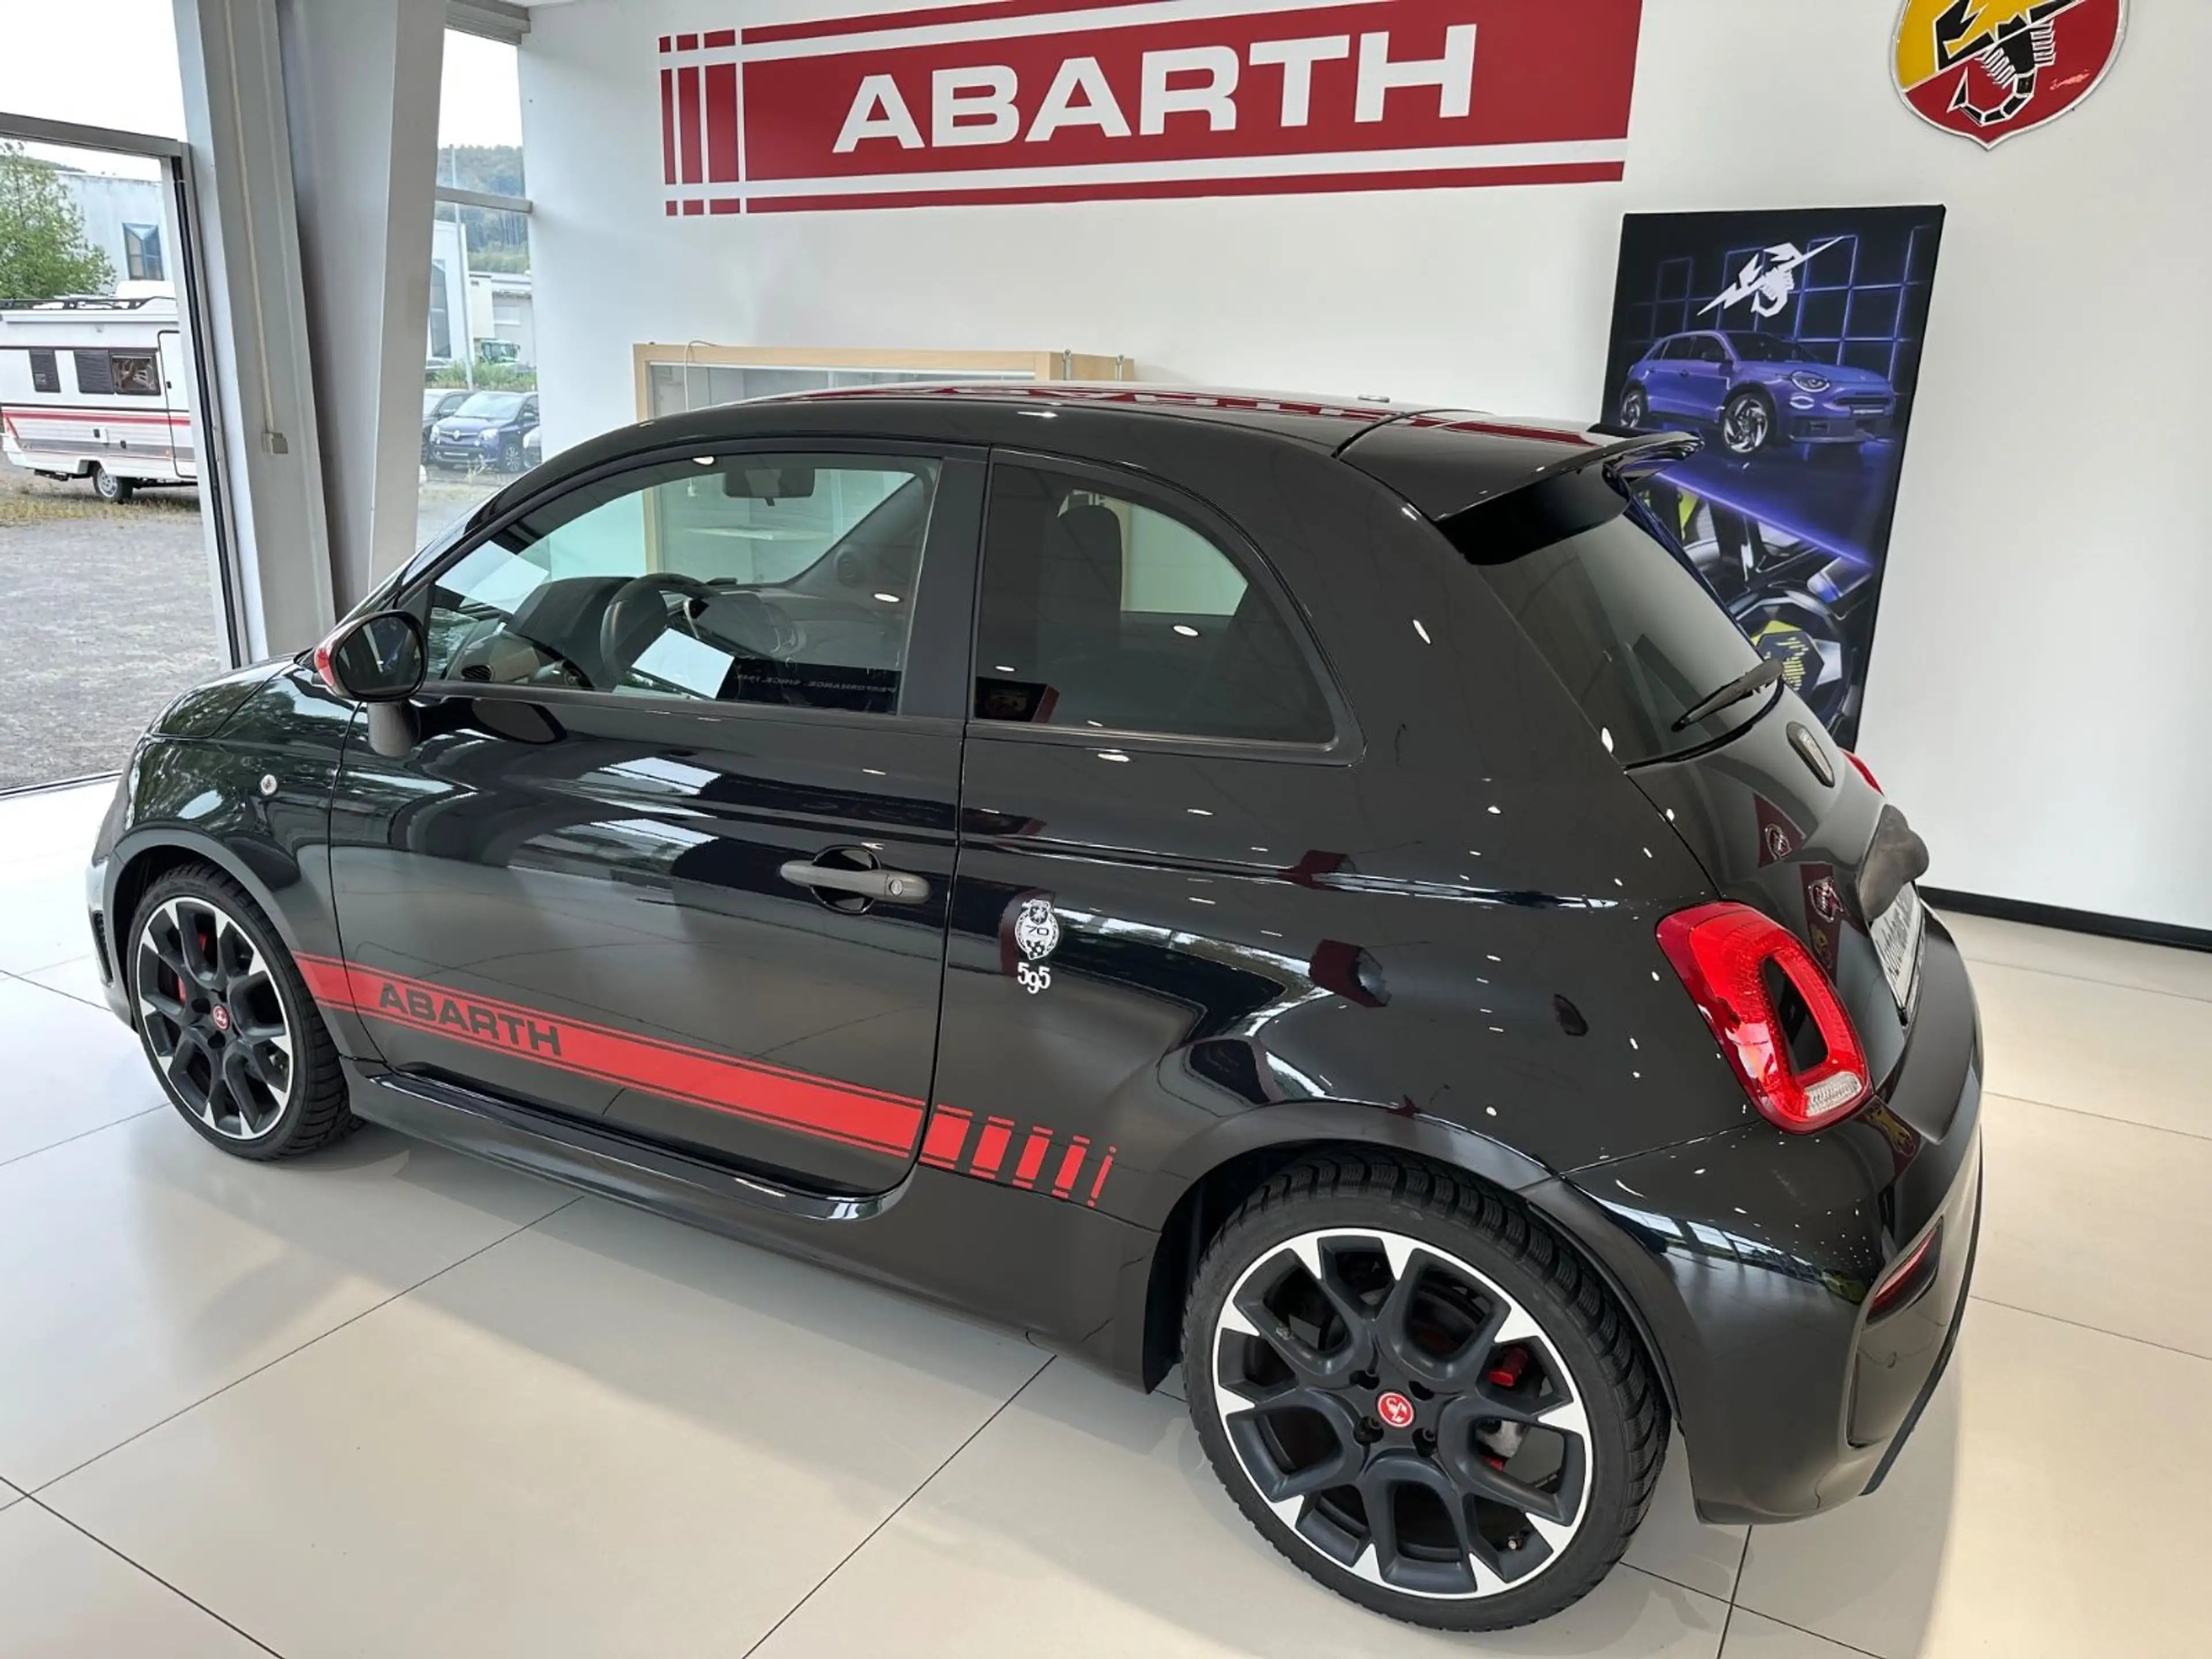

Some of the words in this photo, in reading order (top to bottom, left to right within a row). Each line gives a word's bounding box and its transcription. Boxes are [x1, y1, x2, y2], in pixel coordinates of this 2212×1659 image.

[832, 23, 1477, 154] ABARTH
[1025, 925, 1050, 935] 70
[1017, 961, 1051, 994] 595
[378, 981, 562, 1056] ABARTH
